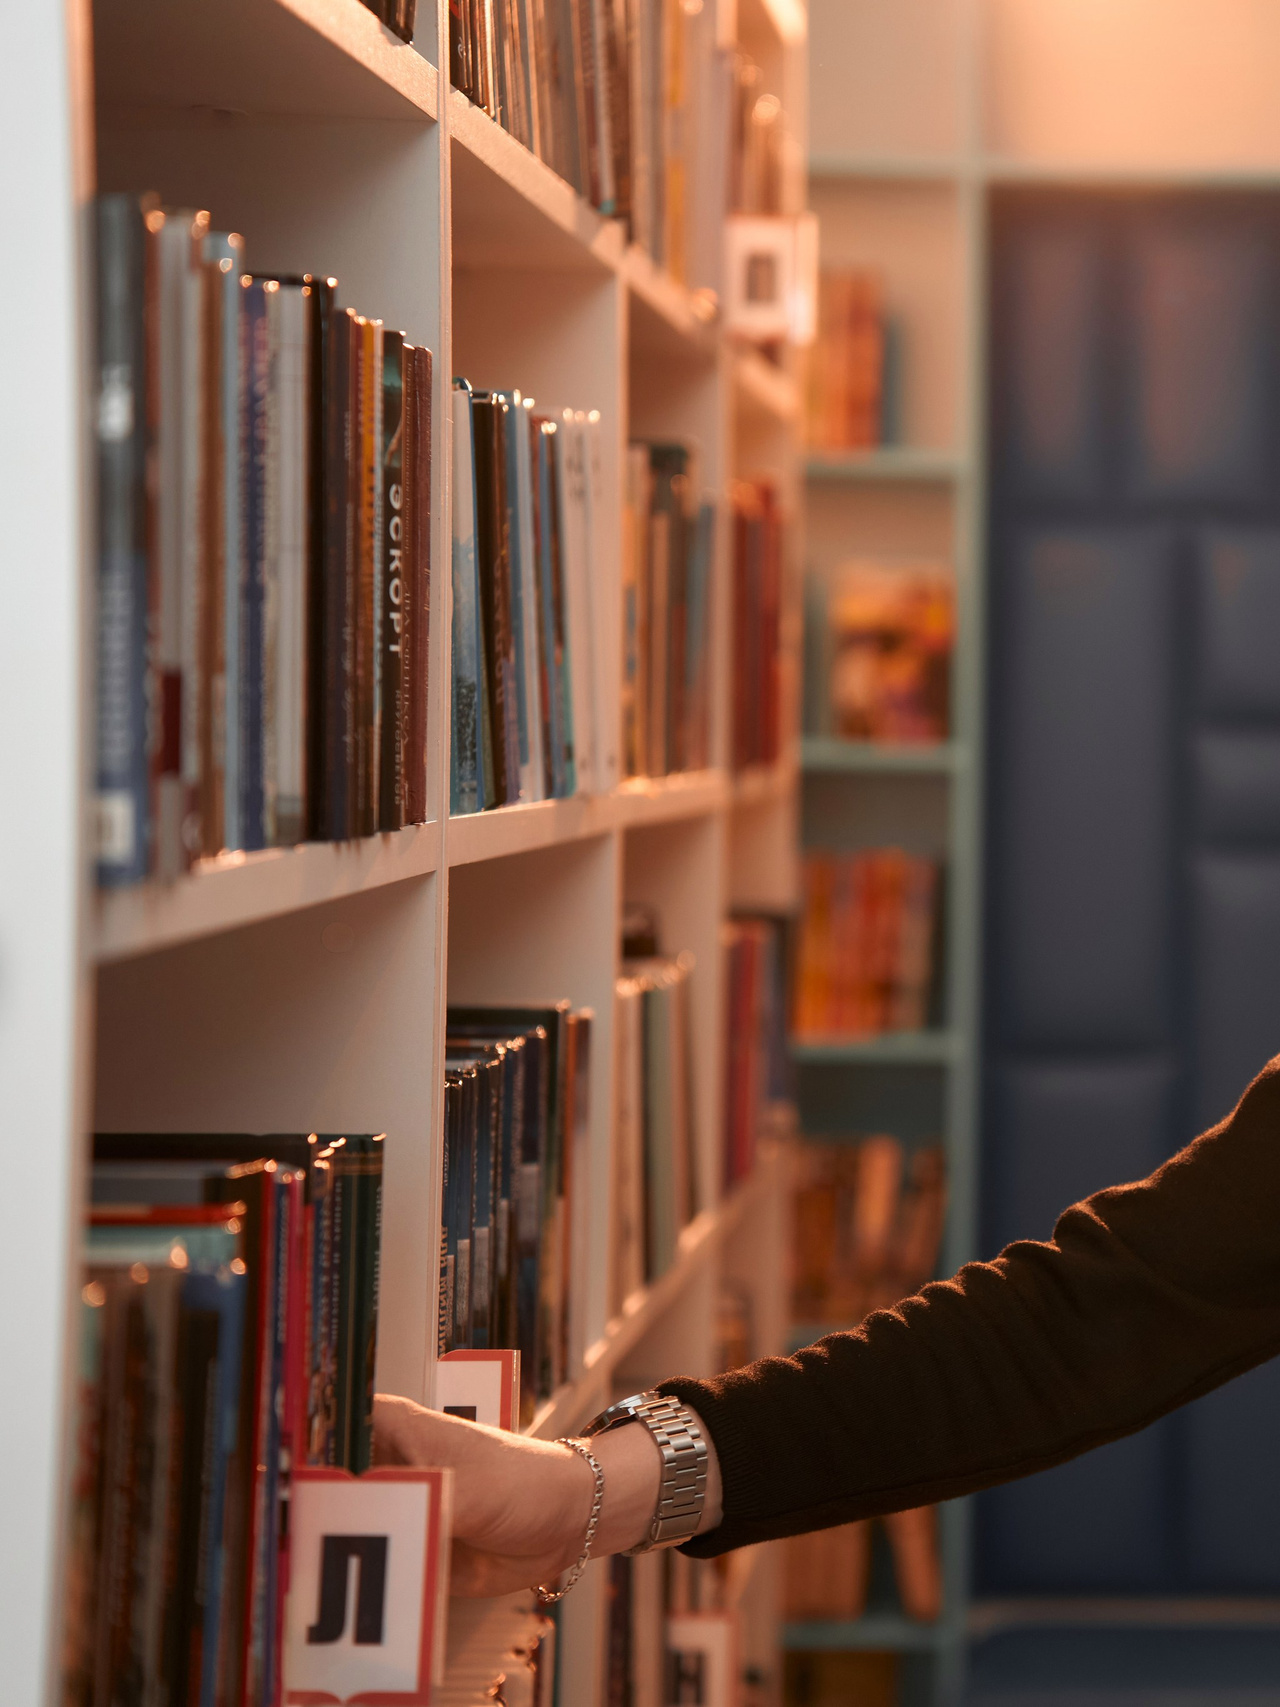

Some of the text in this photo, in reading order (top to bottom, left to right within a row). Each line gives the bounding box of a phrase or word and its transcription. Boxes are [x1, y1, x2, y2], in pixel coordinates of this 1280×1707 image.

[389, 483, 403, 658] ЭСКОРТ
[403, 582, 411, 626] ДВА
[306, 1534, 389, 1646] Л
